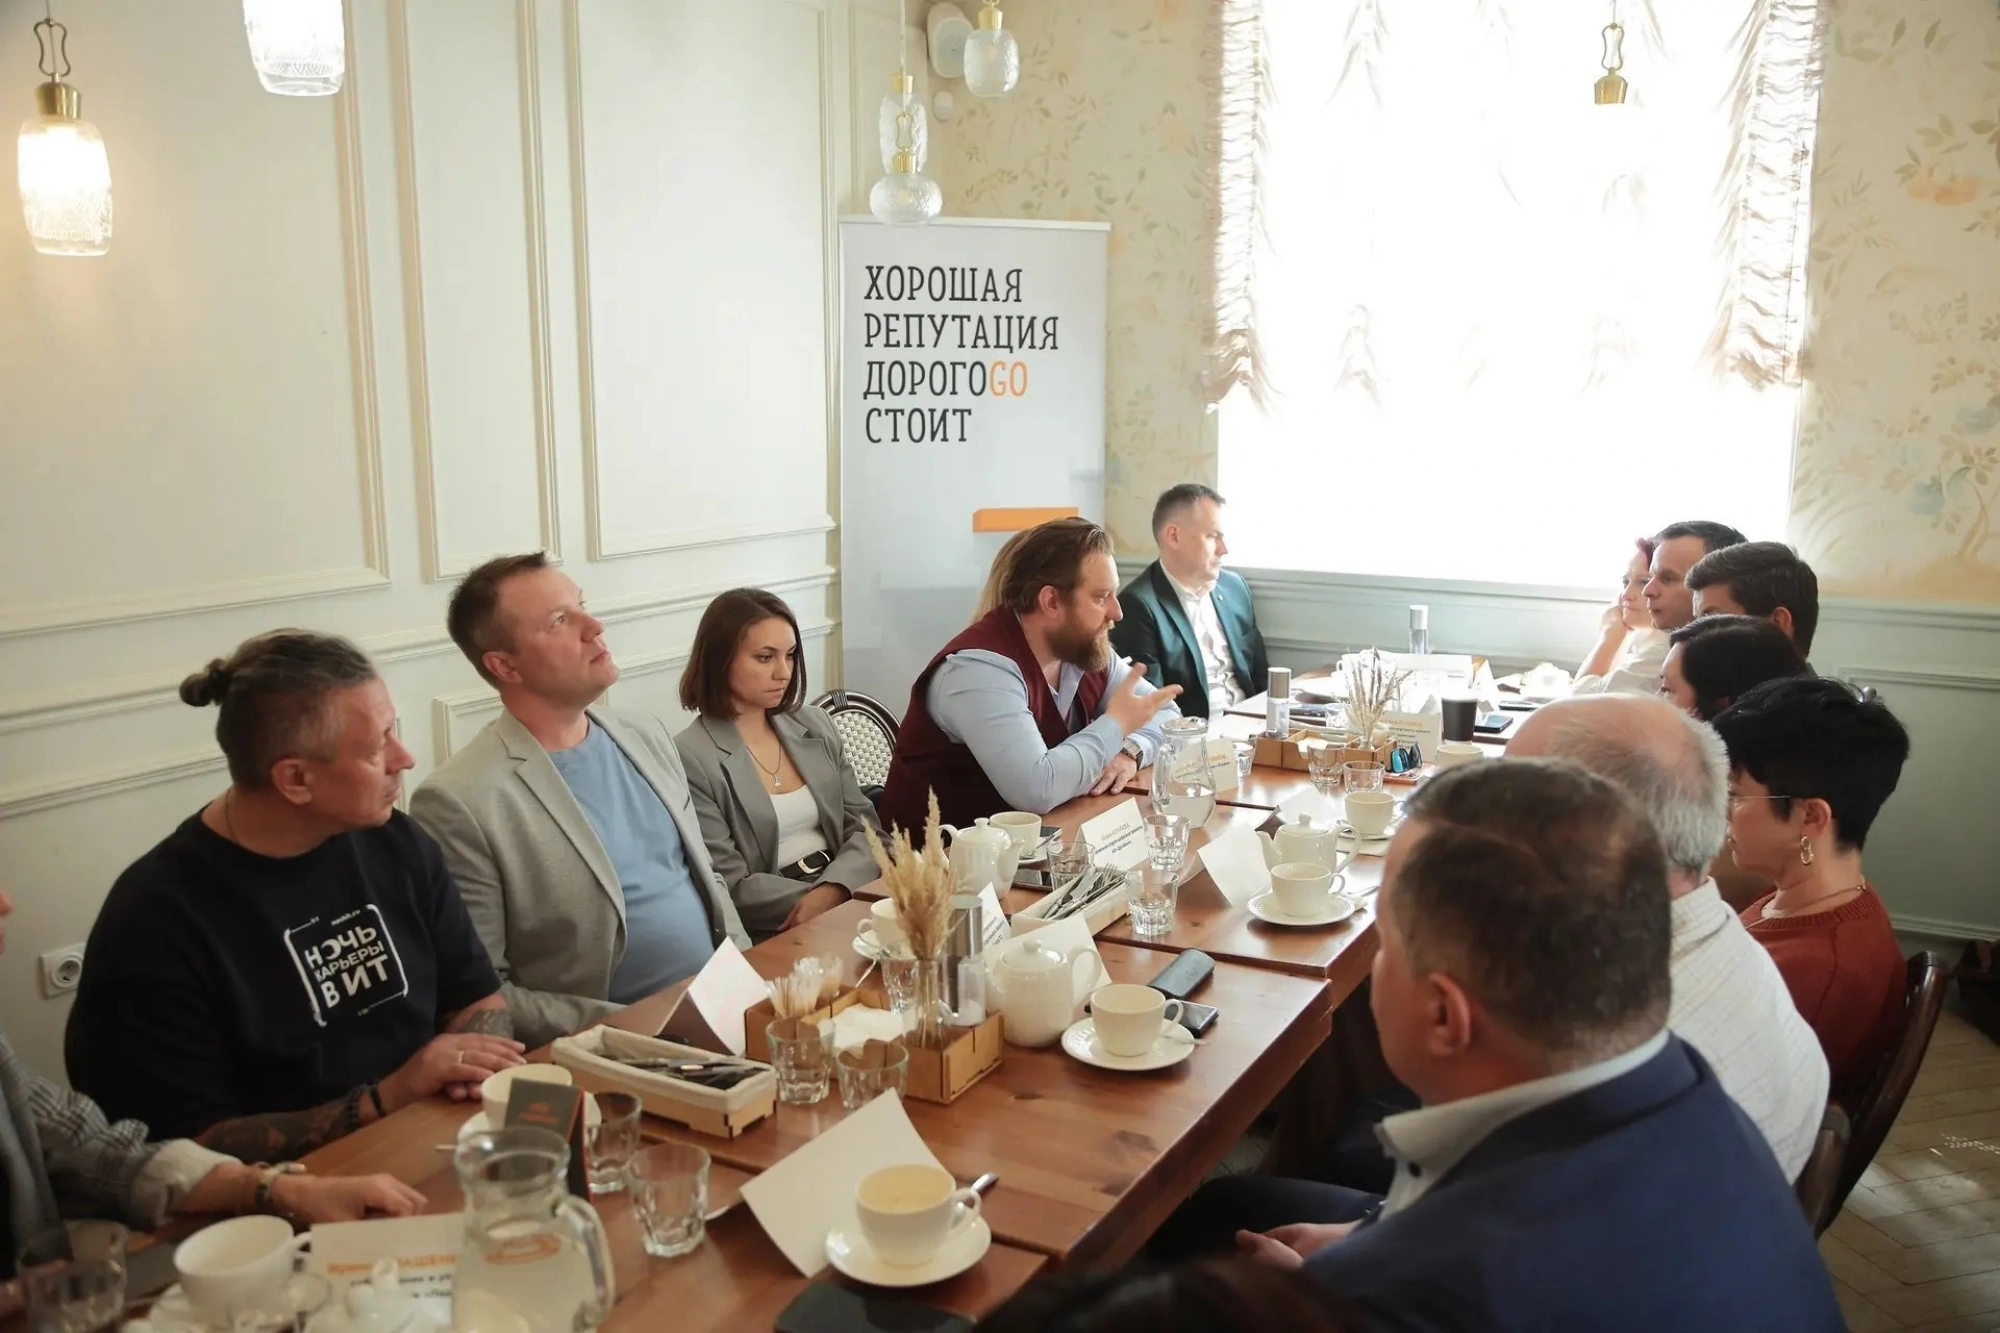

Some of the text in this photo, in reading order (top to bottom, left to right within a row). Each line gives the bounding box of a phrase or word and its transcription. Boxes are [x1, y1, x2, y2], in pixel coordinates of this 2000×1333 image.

[864, 264, 1022, 302] ХОРОШАЯ
[864, 313, 1059, 353] РЕПУТАЦИЯ
[865, 407, 972, 443] СТОИТ
[304, 926, 377, 969] НОЧЬ
[313, 940, 385, 982] КАРЬЕРЫ
[320, 954, 389, 1008] В ИТ
